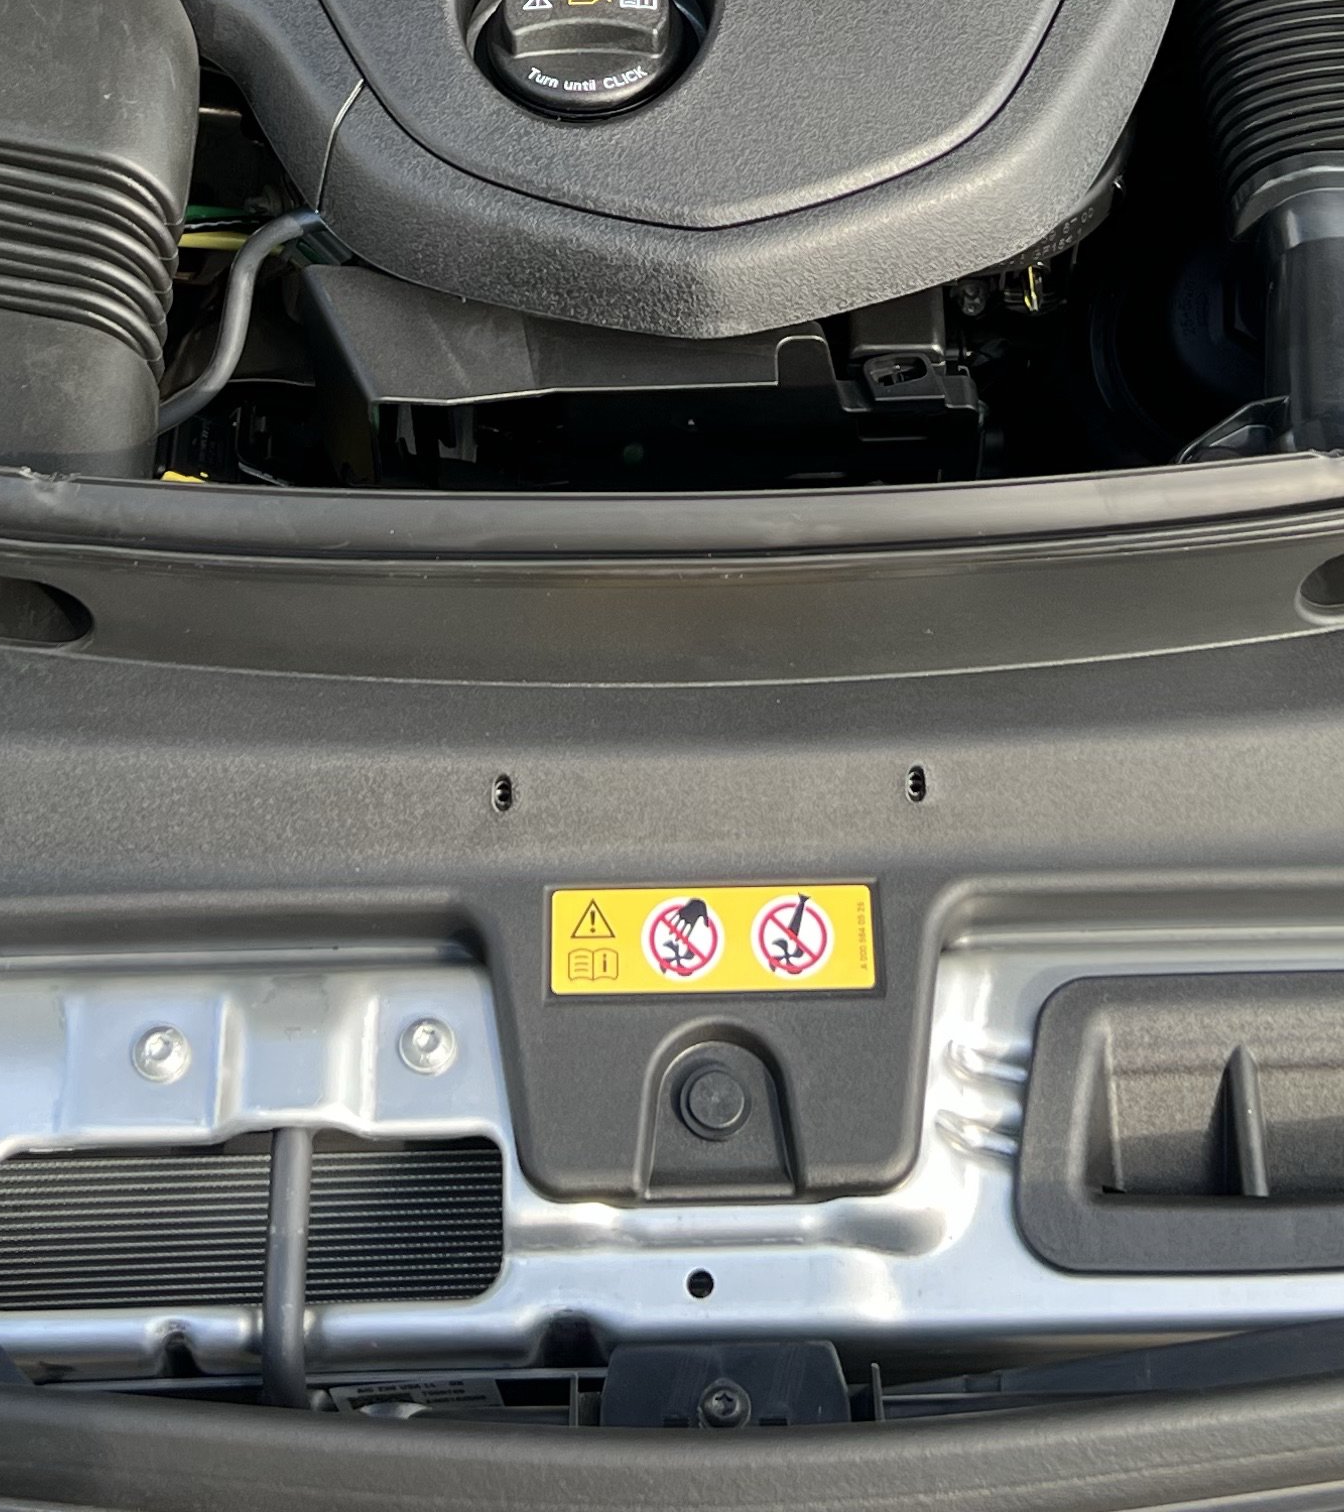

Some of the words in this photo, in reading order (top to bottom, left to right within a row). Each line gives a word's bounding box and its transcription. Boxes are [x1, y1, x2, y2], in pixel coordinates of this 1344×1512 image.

[528, 66, 559, 88] Turn
[563, 79, 597, 91] until
[602, 65, 648, 89] CLICK
